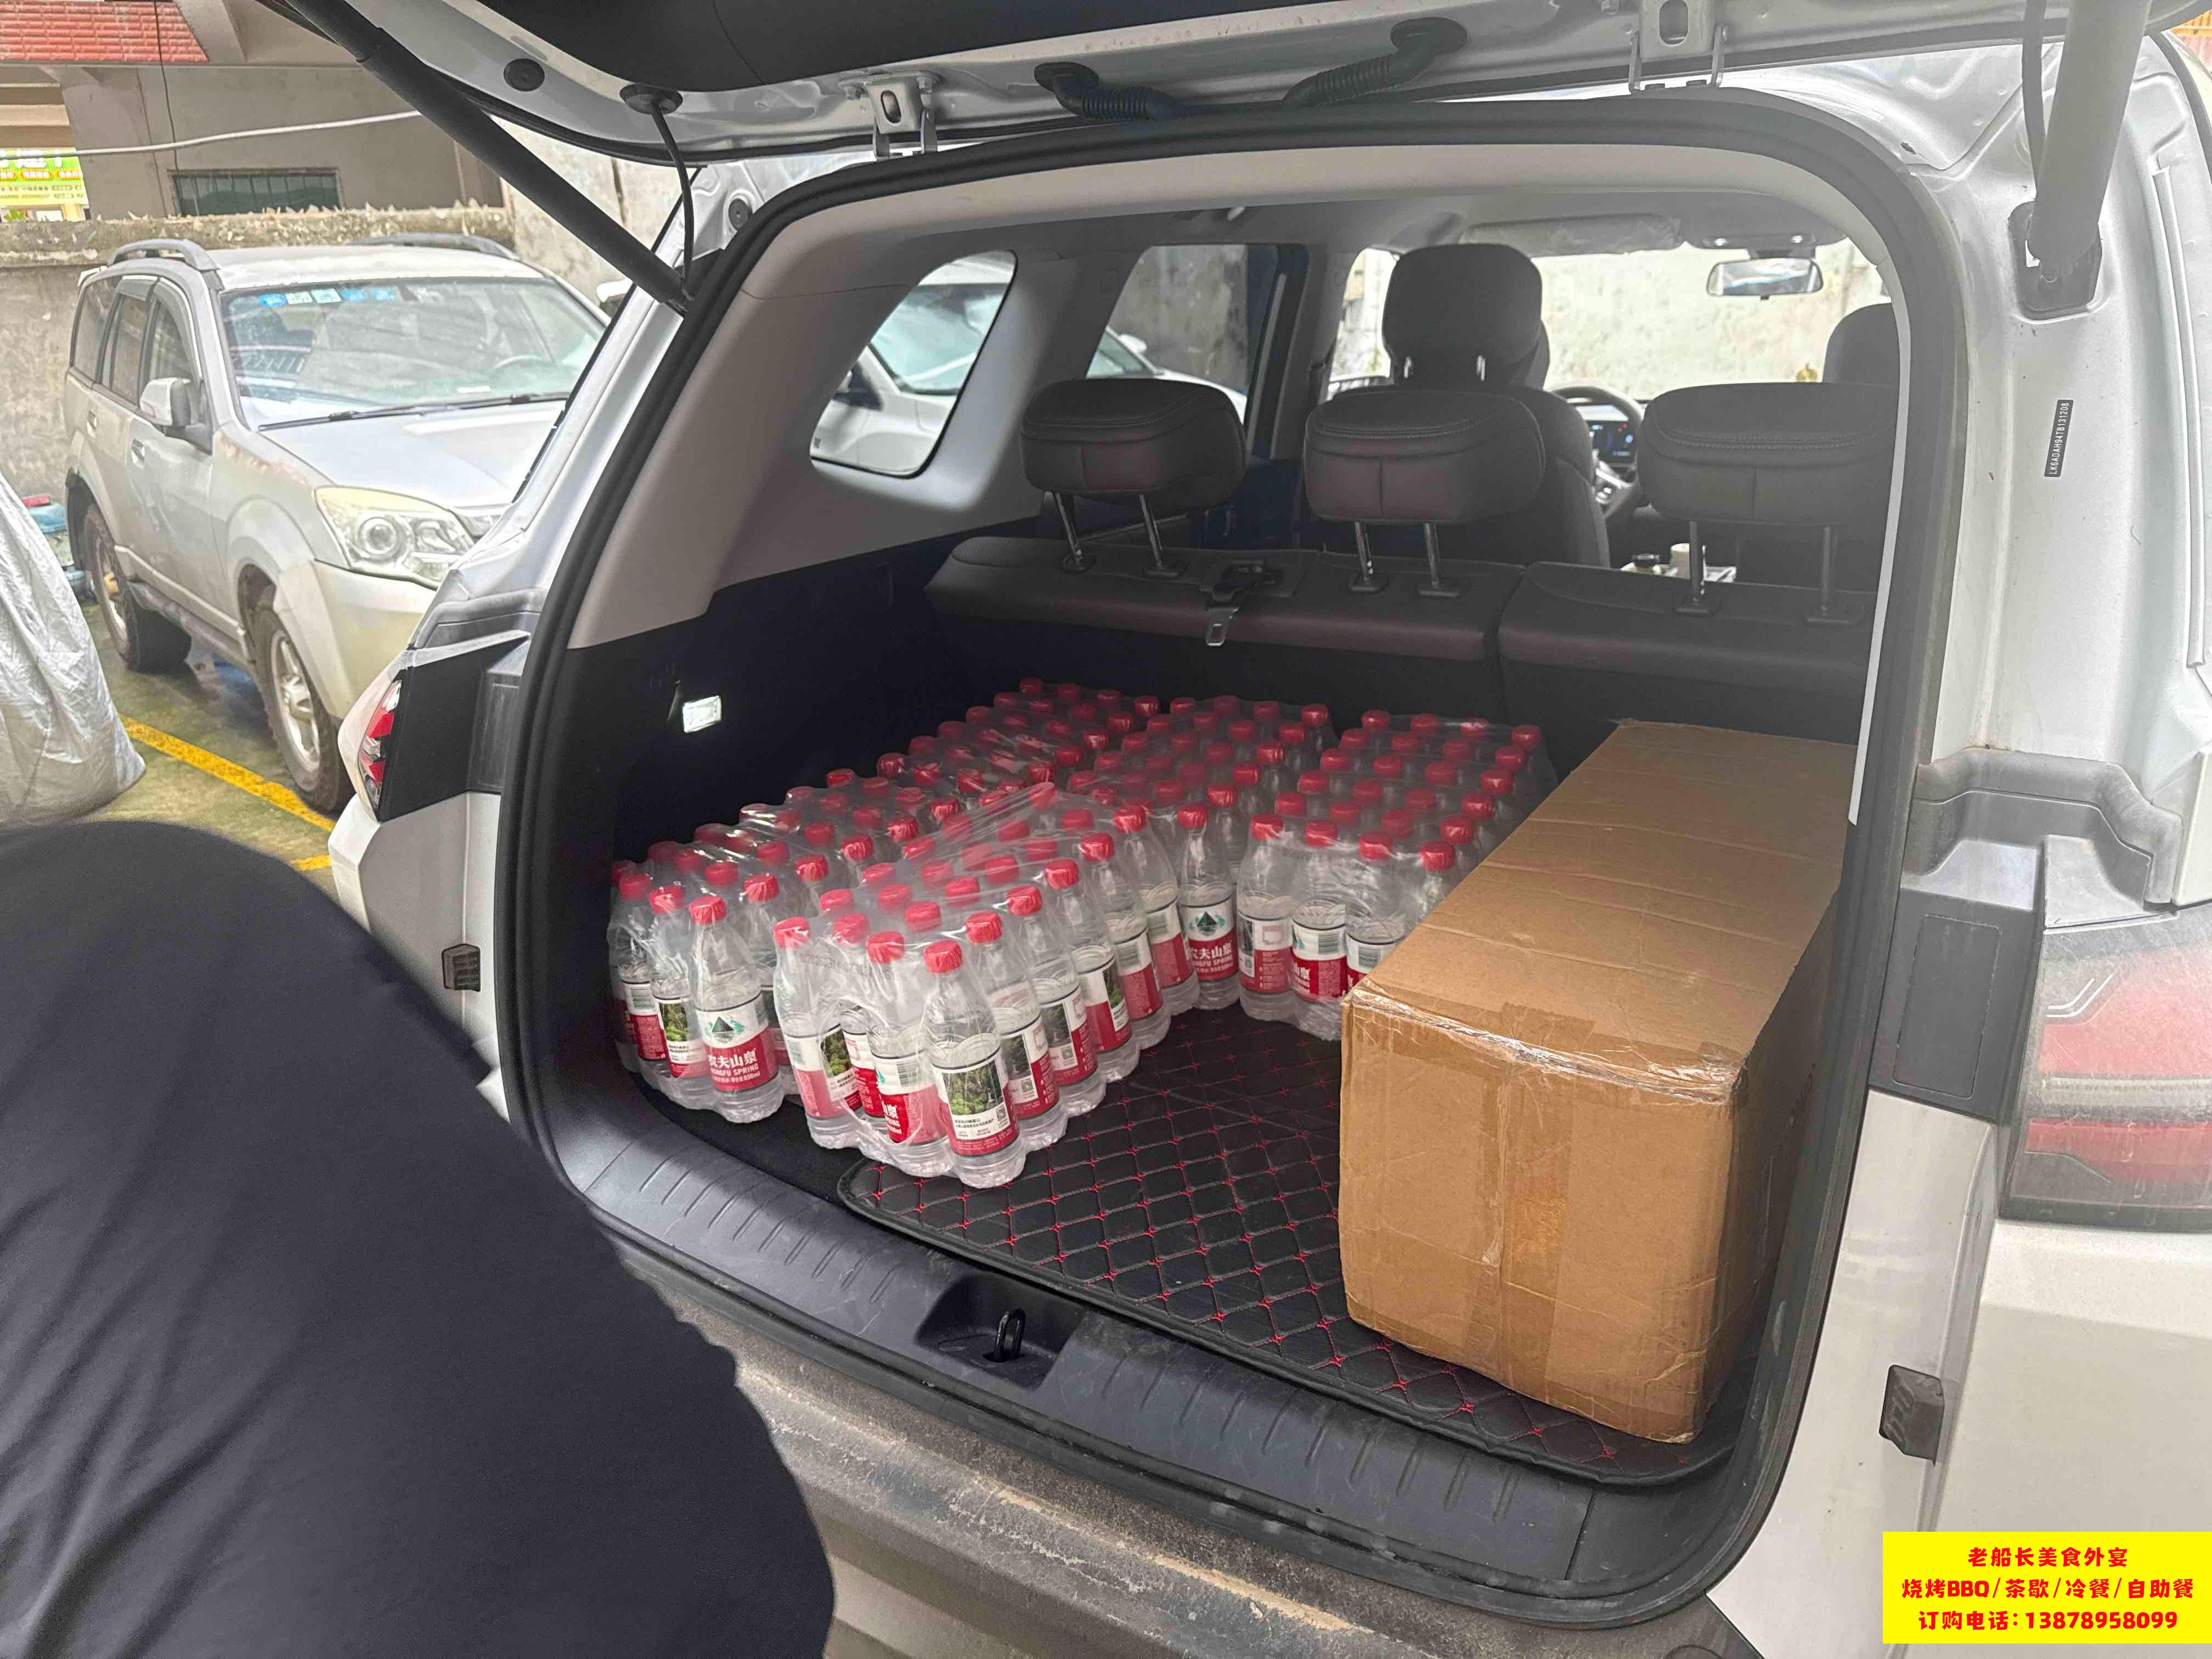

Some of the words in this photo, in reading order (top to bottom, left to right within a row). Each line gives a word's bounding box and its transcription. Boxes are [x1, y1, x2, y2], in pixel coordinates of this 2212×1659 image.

[708, 1049, 757, 1069] 农夫山泉
[733, 1063, 759, 1076] SPRING
